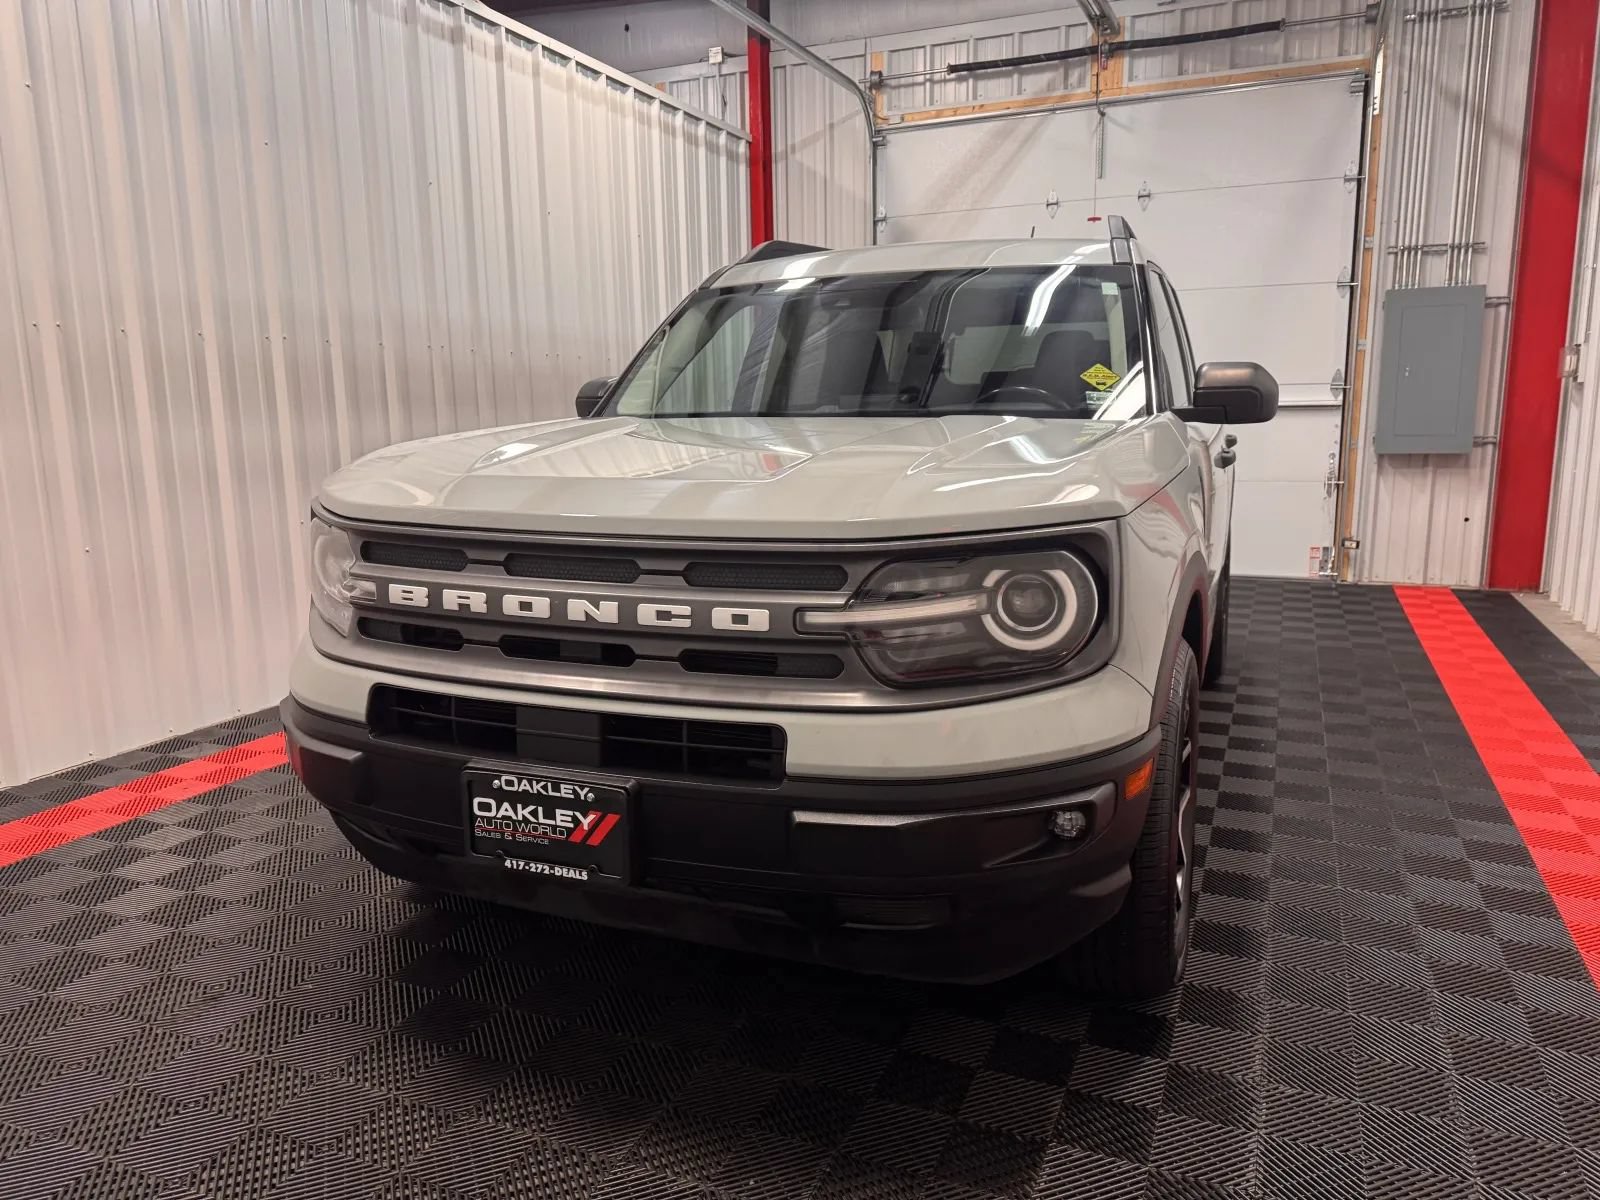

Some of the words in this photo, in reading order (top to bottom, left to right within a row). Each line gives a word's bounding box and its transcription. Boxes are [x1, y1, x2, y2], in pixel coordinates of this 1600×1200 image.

[388, 583, 770, 632] BRONCO
[500, 775, 590, 801] OAKLEY
[472, 796, 597, 831] OAKLEY
[474, 817, 513, 831] AUTO
[515, 821, 567, 838] WORLD
[504, 831, 513, 840] &
[504, 859, 588, 880] 417-272-DEALS
